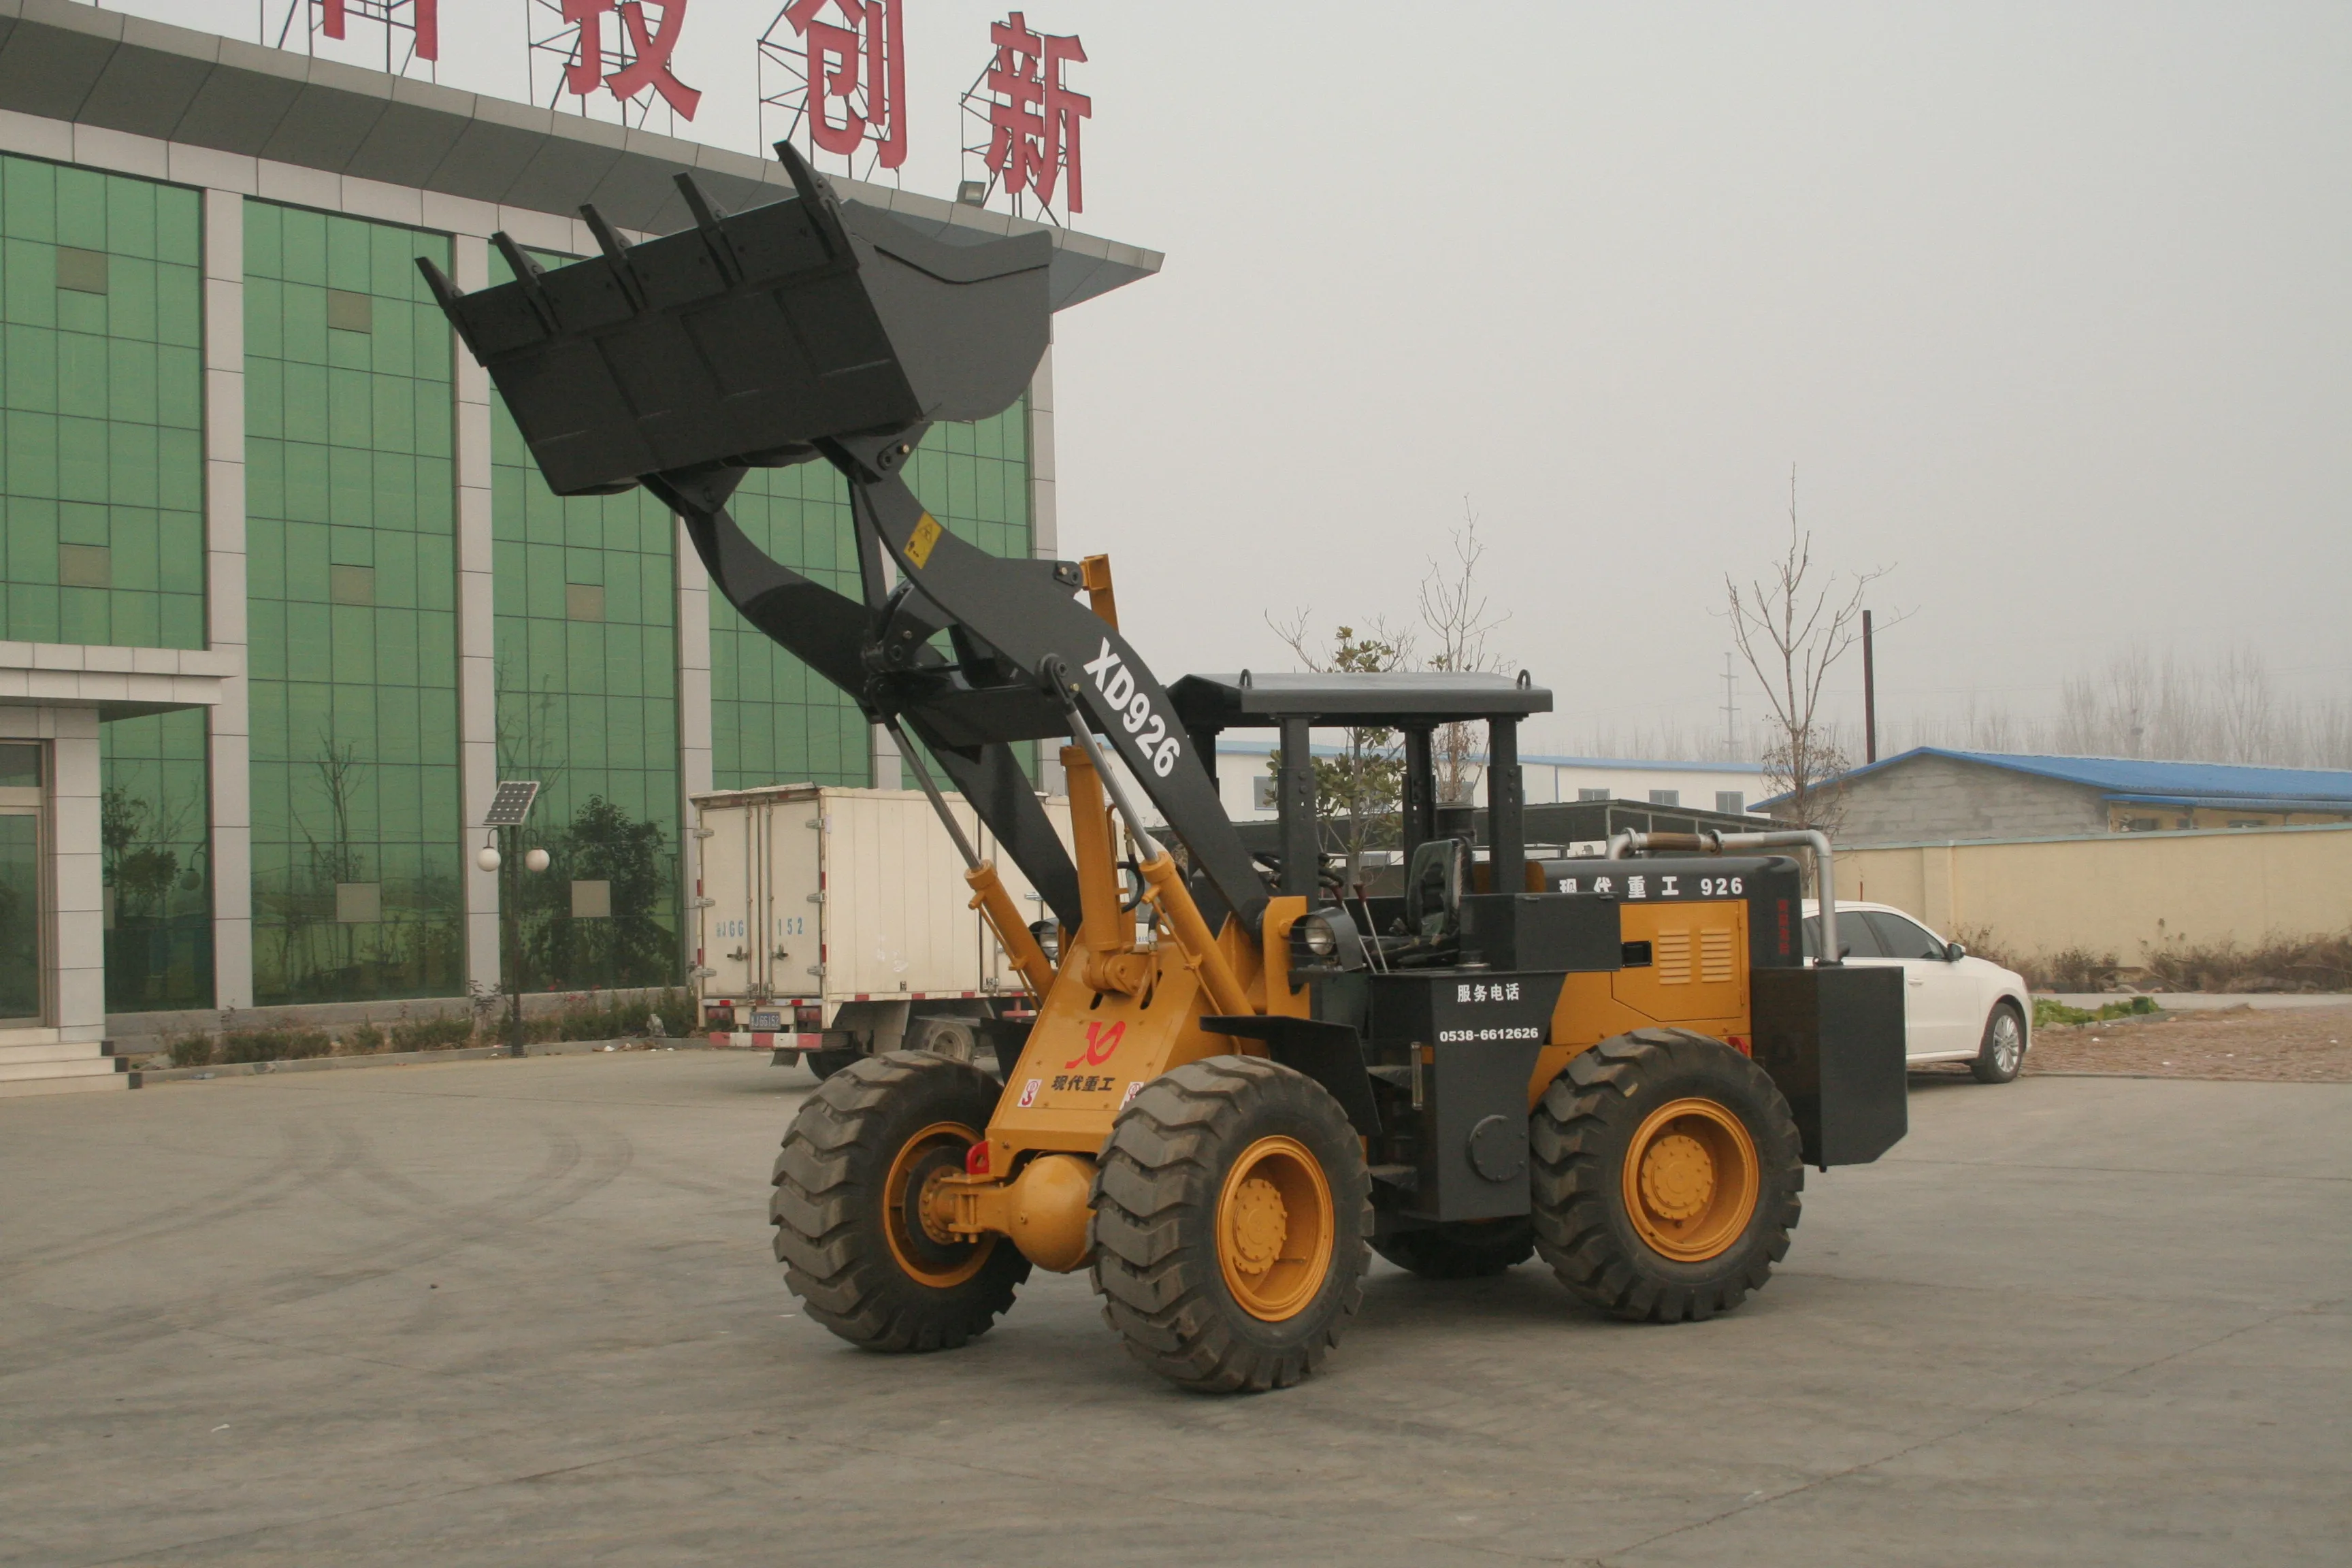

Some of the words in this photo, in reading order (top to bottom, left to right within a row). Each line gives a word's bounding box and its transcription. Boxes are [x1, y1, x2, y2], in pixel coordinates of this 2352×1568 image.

[323, 0, 1091, 214] 技创新
[1083, 637, 1181, 778] XD926
[1559, 875, 1680, 898] 现代重工
[1701, 877, 1743, 896] 926
[778, 917, 803, 936] 152
[1457, 983, 1520, 1002] 服务电话
[1439, 1028, 1538, 1042] 0538-6612626
[1051, 1075, 1115, 1092] 现代重工
